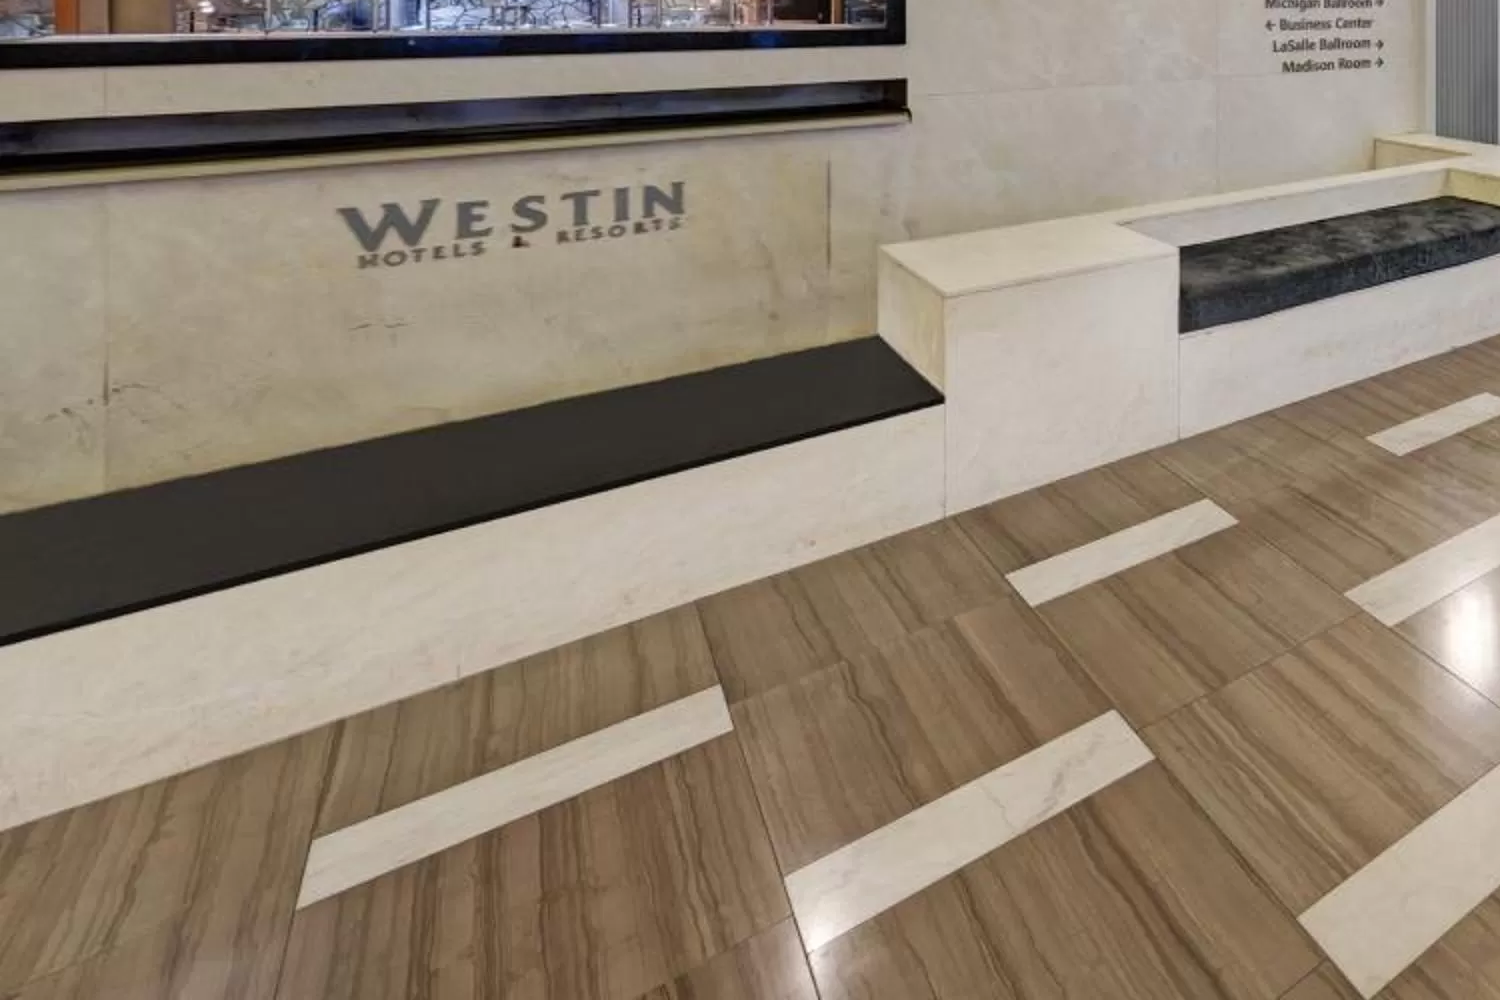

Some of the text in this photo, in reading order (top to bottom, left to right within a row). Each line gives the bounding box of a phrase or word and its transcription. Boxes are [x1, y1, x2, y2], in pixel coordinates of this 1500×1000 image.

[1279, 18, 1373, 31] Business Center
[1272, 37, 1371, 53] LaSalle Ballroom
[1282, 57, 1371, 73] Madison Room
[336, 181, 686, 252] WESTIN
[357, 216, 683, 269] HOTELS & RESORTS
